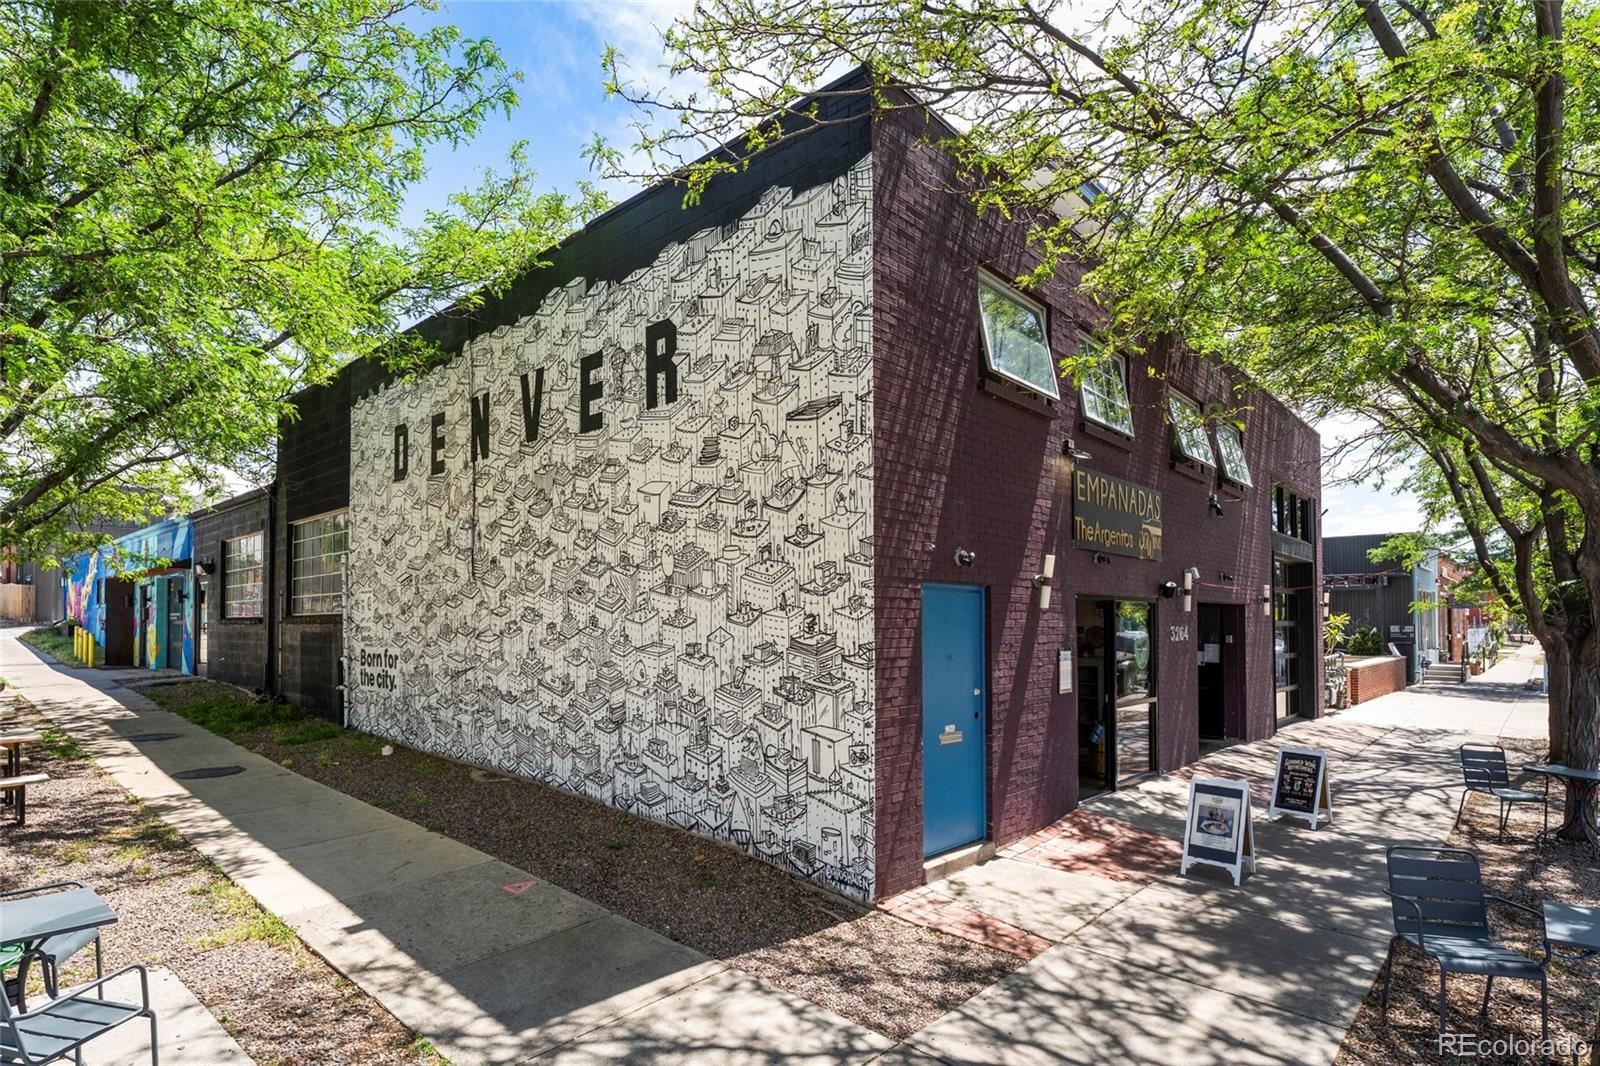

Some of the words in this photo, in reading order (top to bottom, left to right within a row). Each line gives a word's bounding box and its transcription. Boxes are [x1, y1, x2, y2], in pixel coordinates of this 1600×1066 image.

[393, 318, 678, 482] DENVER
[1076, 470, 1161, 520] EMPANADAS
[1170, 625, 1188, 641] 3264
[360, 648, 382, 667] Born
[384, 648, 399, 669] for
[360, 668, 375, 686] the
[376, 668, 397, 692] city.
